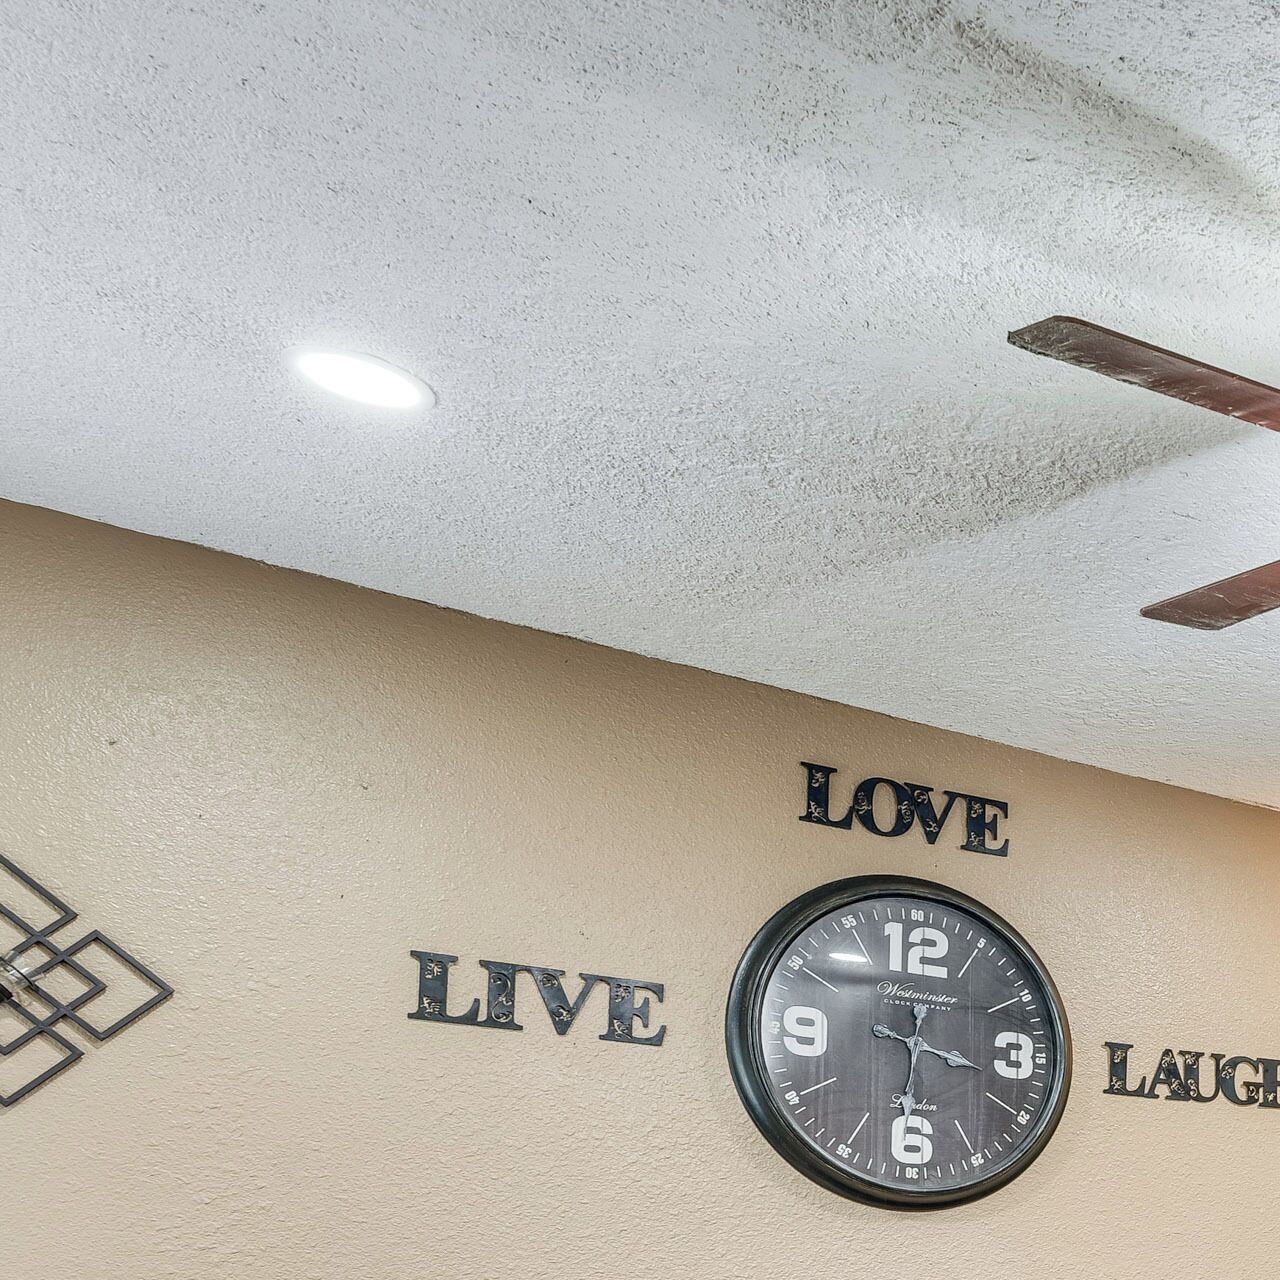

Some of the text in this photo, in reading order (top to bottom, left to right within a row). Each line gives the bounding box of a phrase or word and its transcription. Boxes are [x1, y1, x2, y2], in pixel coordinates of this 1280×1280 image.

[799, 761, 1009, 858] LOVE
[841, 914, 857, 929] 55
[910, 909, 925, 922] 60
[884, 921, 949, 979] 12
[976, 938, 987, 949] 5
[787, 955, 804, 971] 50
[407, 950, 667, 1047] LIVE
[877, 980, 958, 1004] Westminster
[1018, 988, 1032, 1003] 10
[883, 998, 911, 1007] CLOCK
[783, 1005, 828, 1057] 9
[993, 1031, 1034, 1080] 3
[1035, 1052, 1046, 1065] 15
[784, 1090, 800, 1106] 40
[889, 1093, 938, 1111] Ldon
[1017, 1110, 1030, 1125] 20
[891, 1115, 934, 1165] 6
[836, 1143, 853, 1159] 35
[970, 1152, 986, 1168] 25
[905, 1166, 920, 1179] 30
